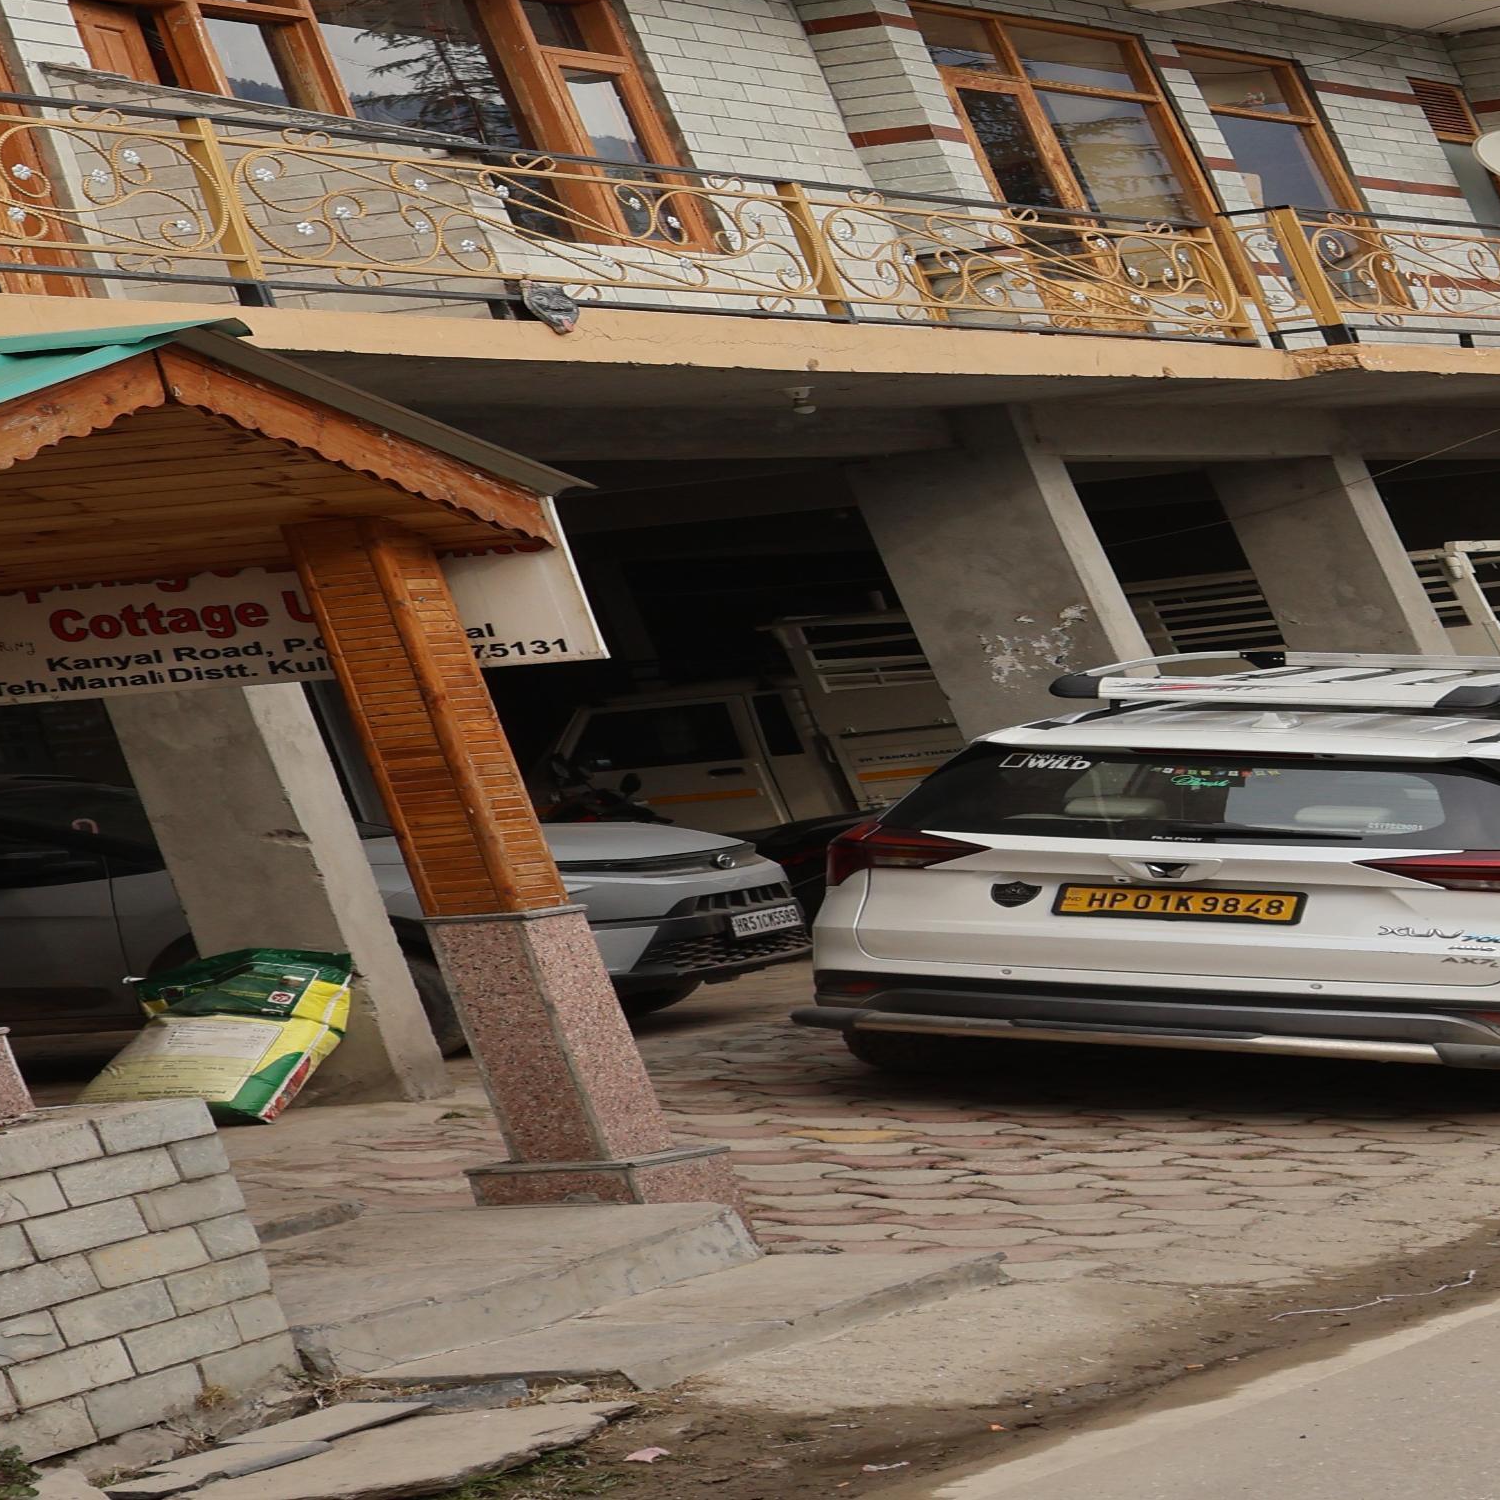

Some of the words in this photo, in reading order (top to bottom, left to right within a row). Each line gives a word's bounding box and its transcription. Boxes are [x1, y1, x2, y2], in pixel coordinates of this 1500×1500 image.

[49, 601, 269, 643] Cottage
[47, 649, 163, 672] Kanyal
[173, 641, 273, 662] Road,
[170, 663, 259, 684] Distt.
[268, 656, 328, 676] Kul
[471, 638, 569, 660] 75131
[1028, 758, 1092, 770] WILD
[1034, 753, 1061, 761] NAT
